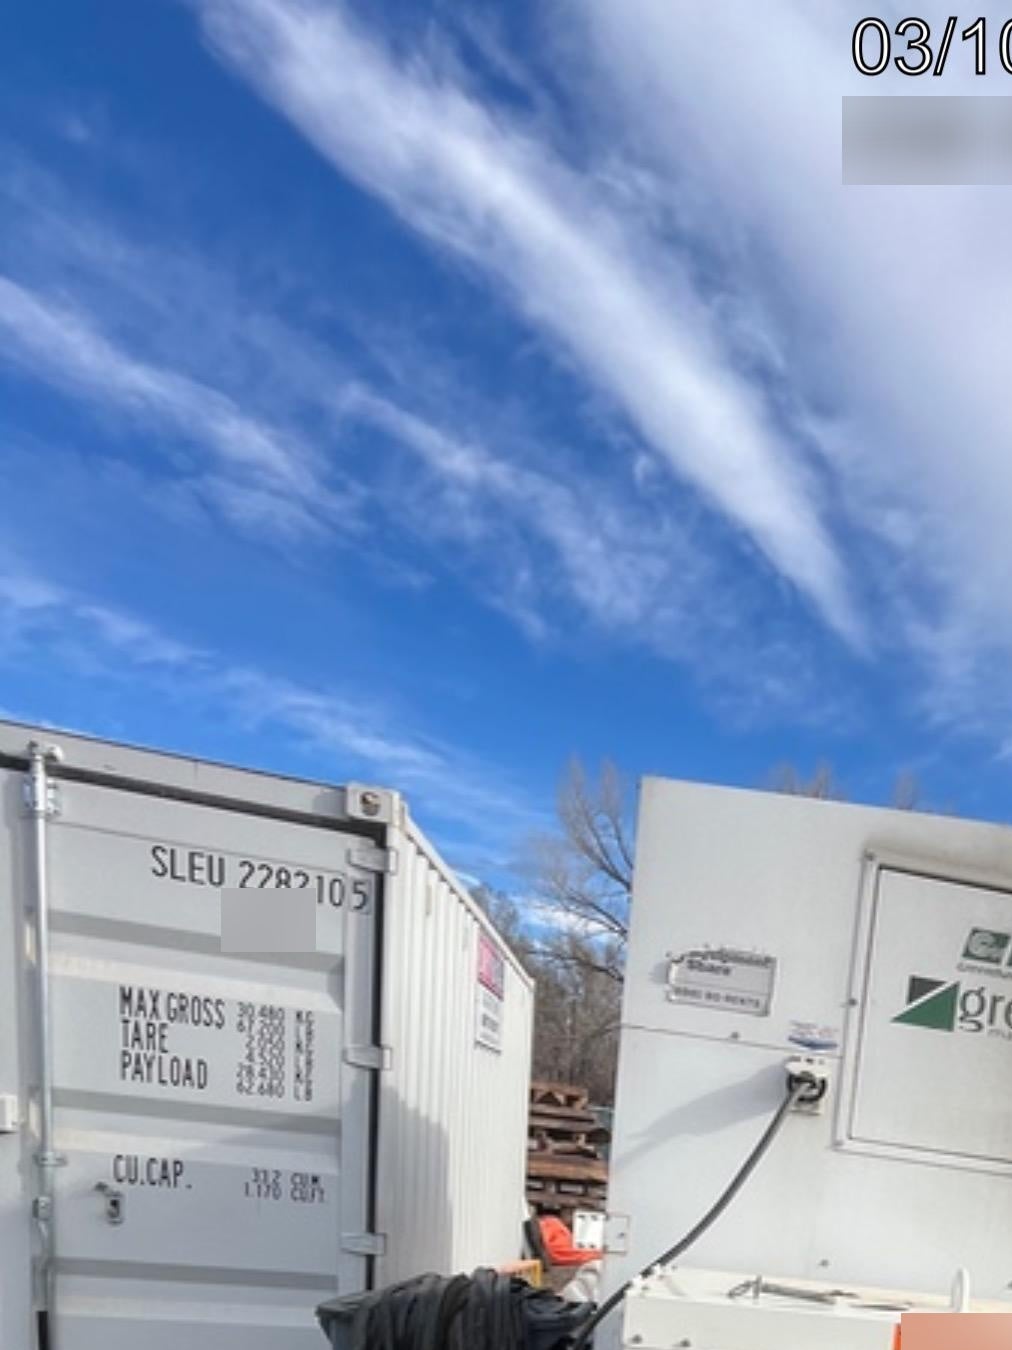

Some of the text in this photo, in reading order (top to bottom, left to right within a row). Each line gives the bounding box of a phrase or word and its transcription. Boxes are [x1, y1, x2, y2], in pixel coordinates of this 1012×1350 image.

[151, 845, 225, 888] SLEU
[119, 986, 161, 1022] MAX
[167, 992, 226, 1030] GROSS
[121, 1019, 169, 1054] TARE
[121, 1050, 208, 1090] PAYLOAD
